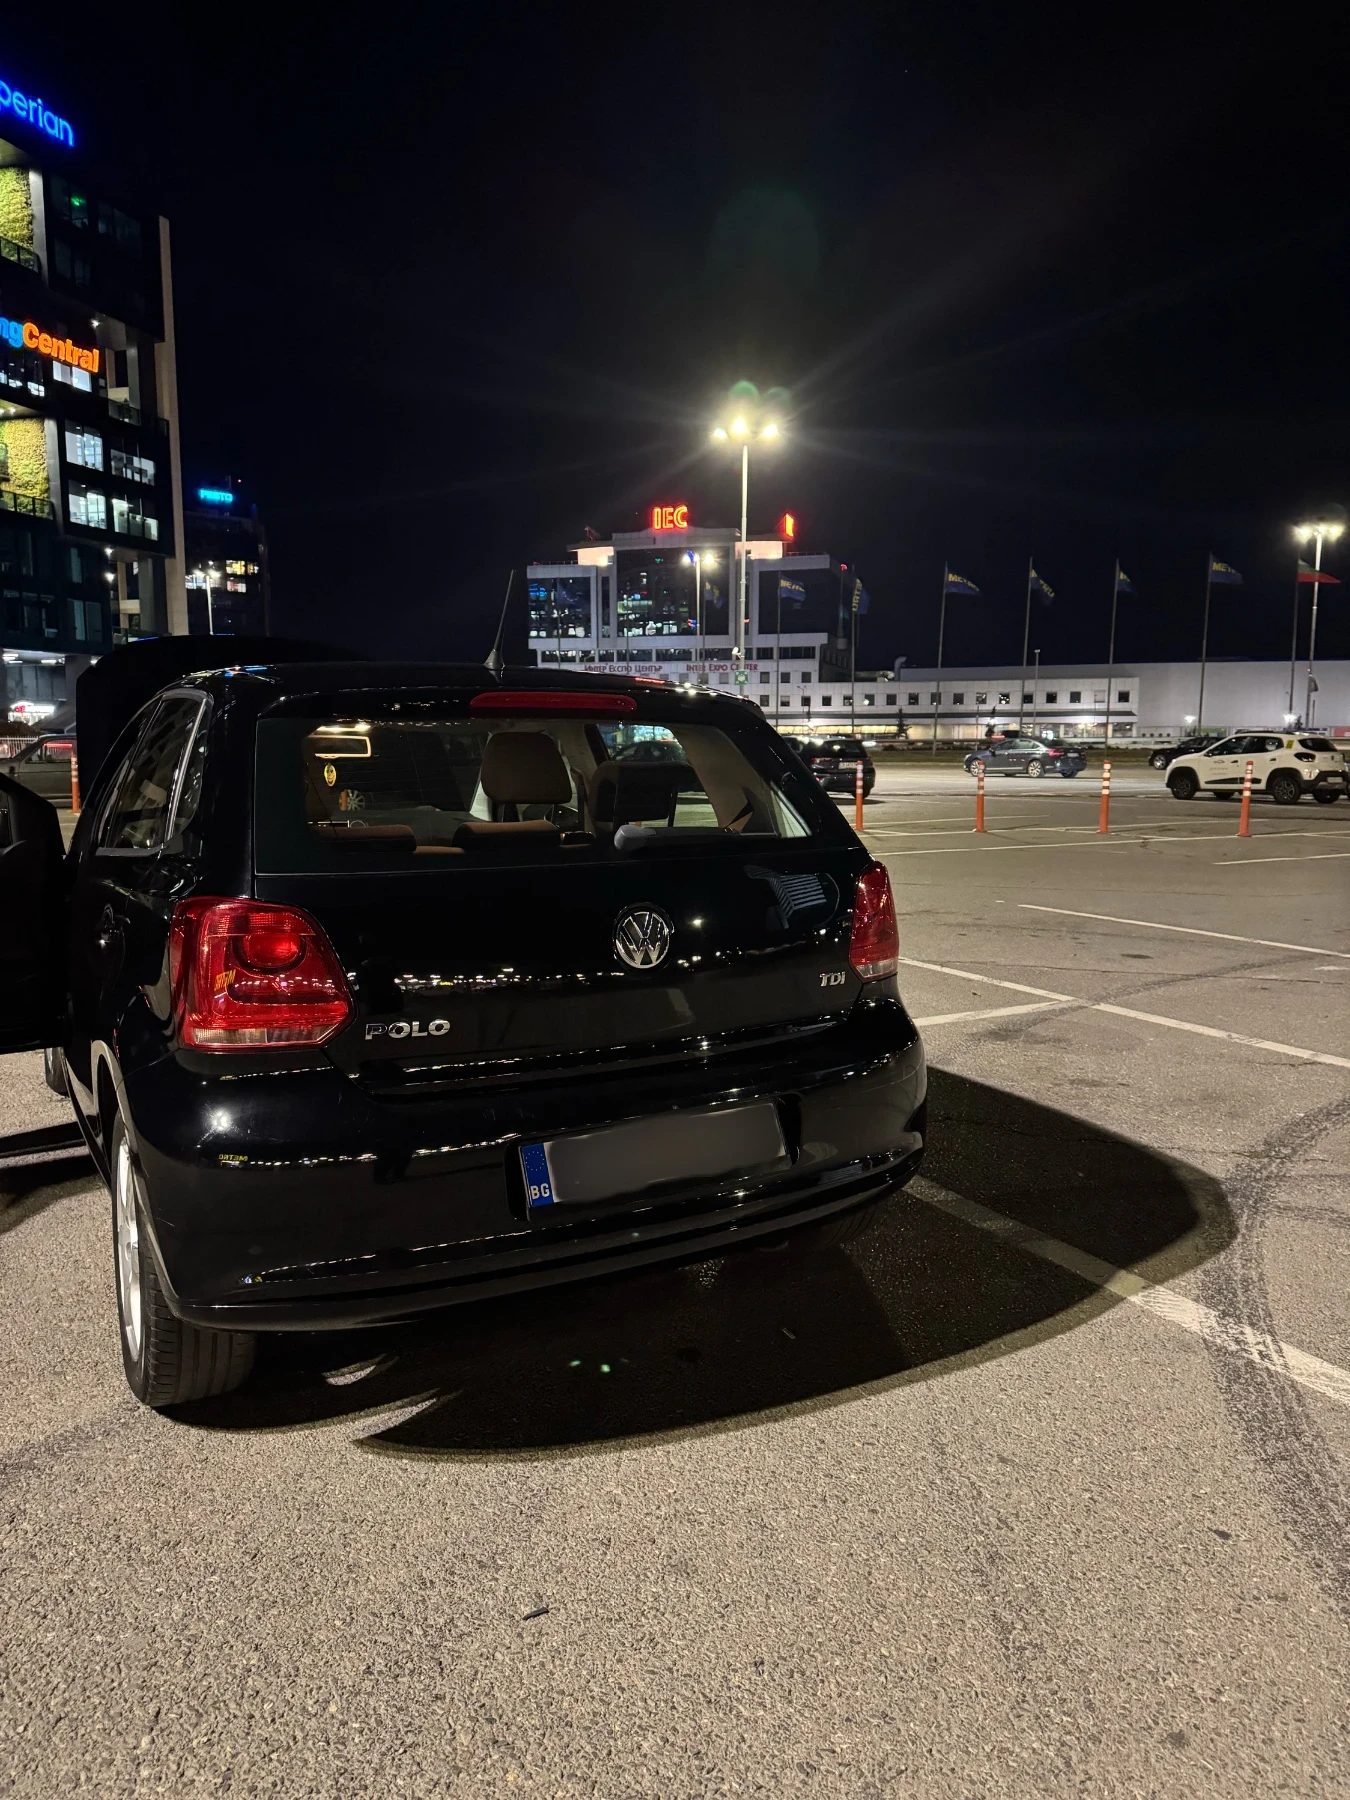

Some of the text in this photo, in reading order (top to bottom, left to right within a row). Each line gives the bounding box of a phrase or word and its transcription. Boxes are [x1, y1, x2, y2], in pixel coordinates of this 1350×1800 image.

[653, 505, 688, 530] IEC
[708, 663, 728, 671] EXPO
[730, 663, 758, 671] CETER
[819, 971, 846, 987] TDI
[364, 1018, 451, 1040] POLO
[530, 1182, 550, 1200] BG
